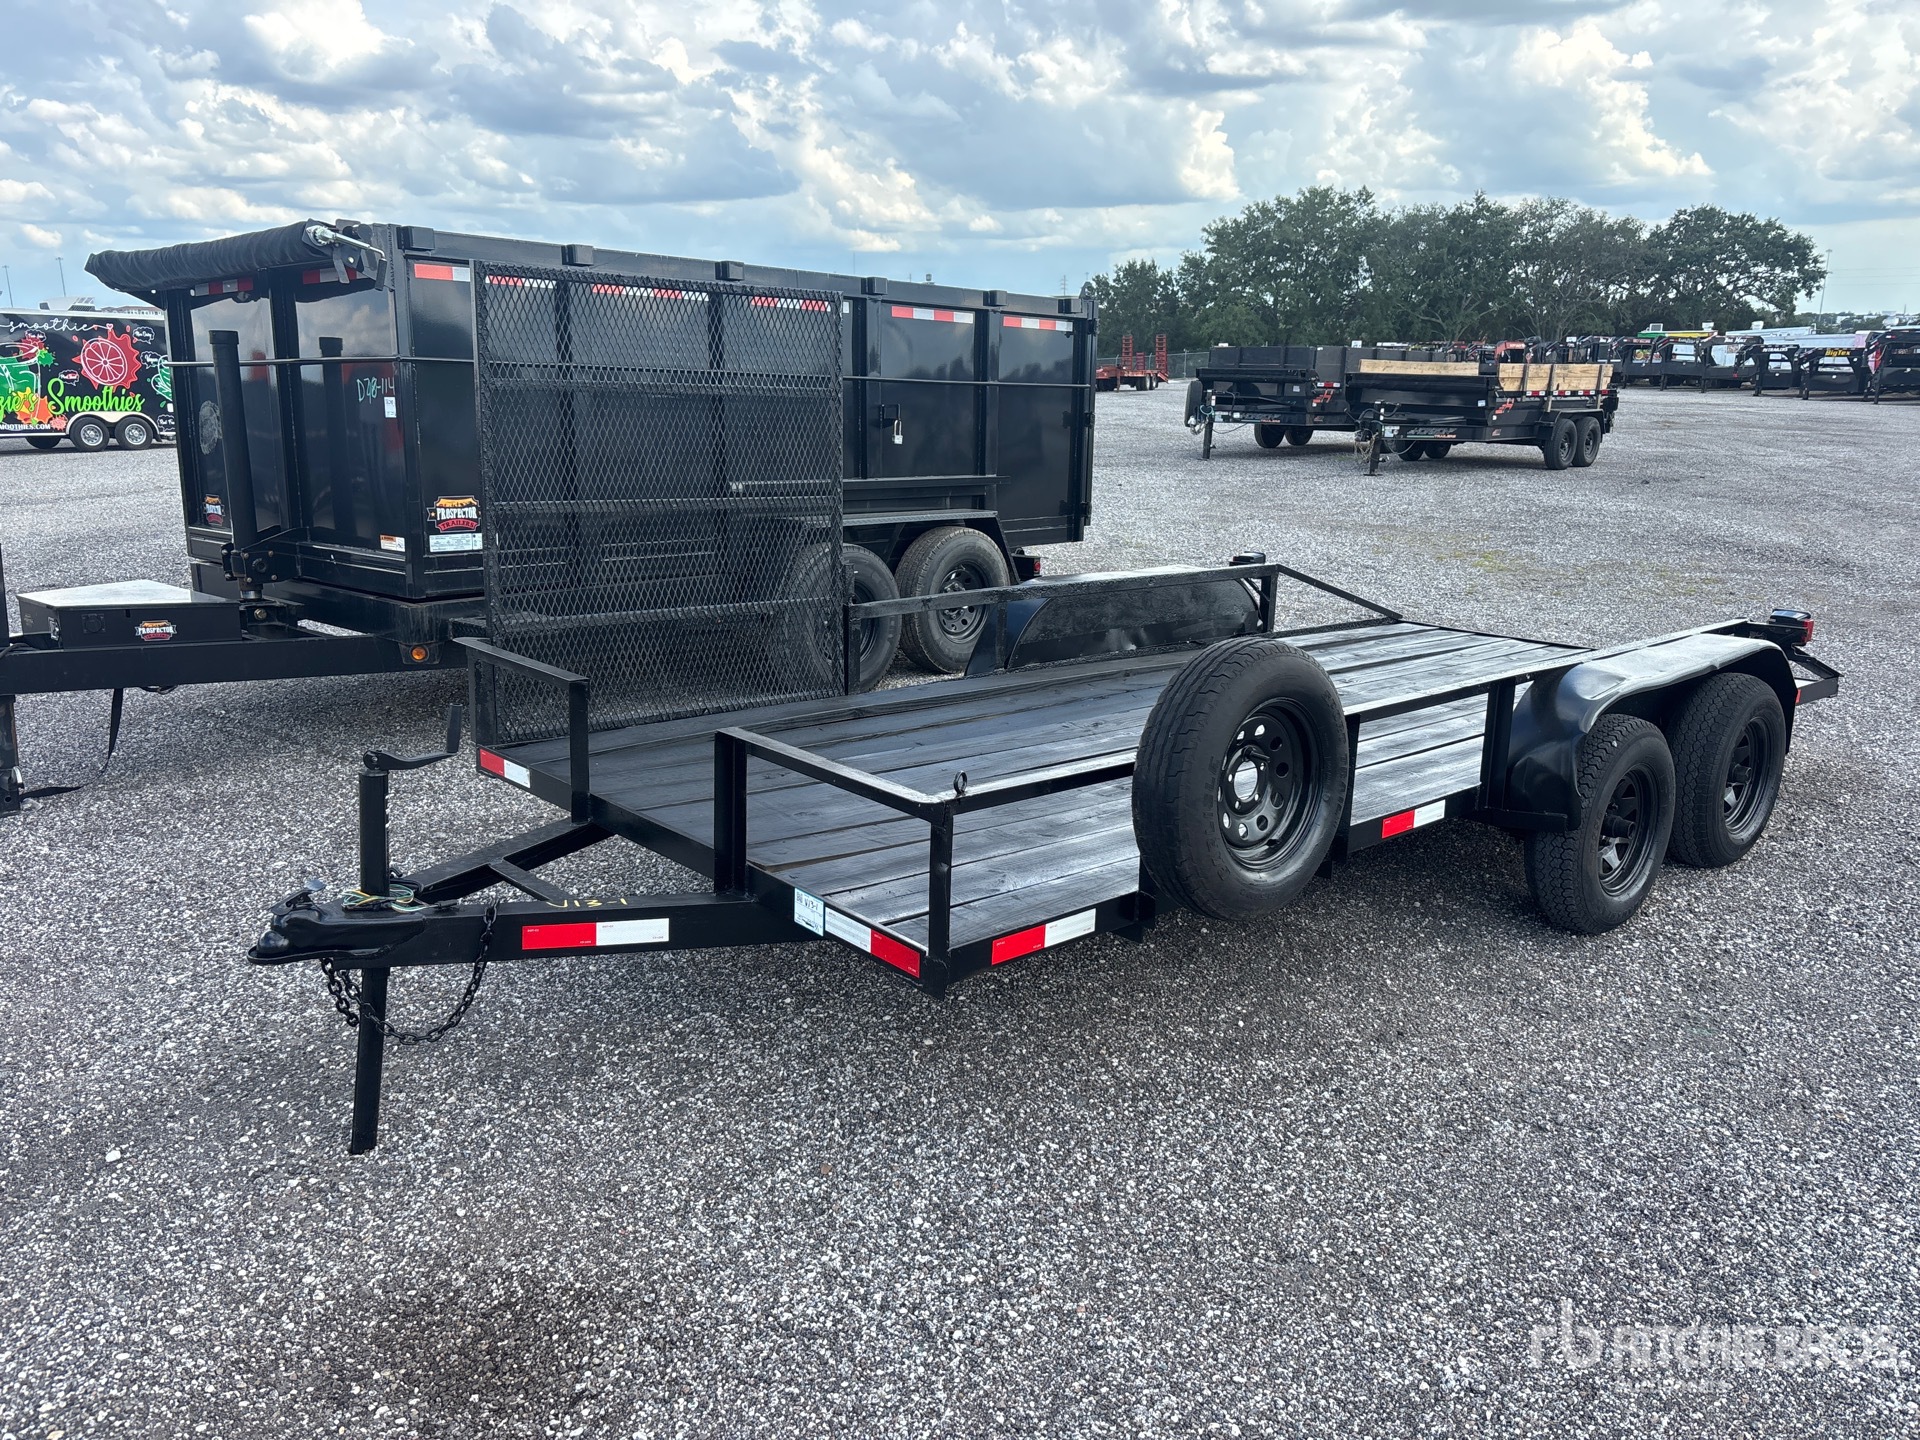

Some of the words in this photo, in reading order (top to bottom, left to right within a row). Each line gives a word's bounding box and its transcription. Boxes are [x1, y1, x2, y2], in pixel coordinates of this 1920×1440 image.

[9, 318, 92, 332] smoothie
[48, 378, 145, 415] Smoothies
[436, 507, 478, 520] PROSPECTOR
[441, 519, 474, 529] TRAILERS
